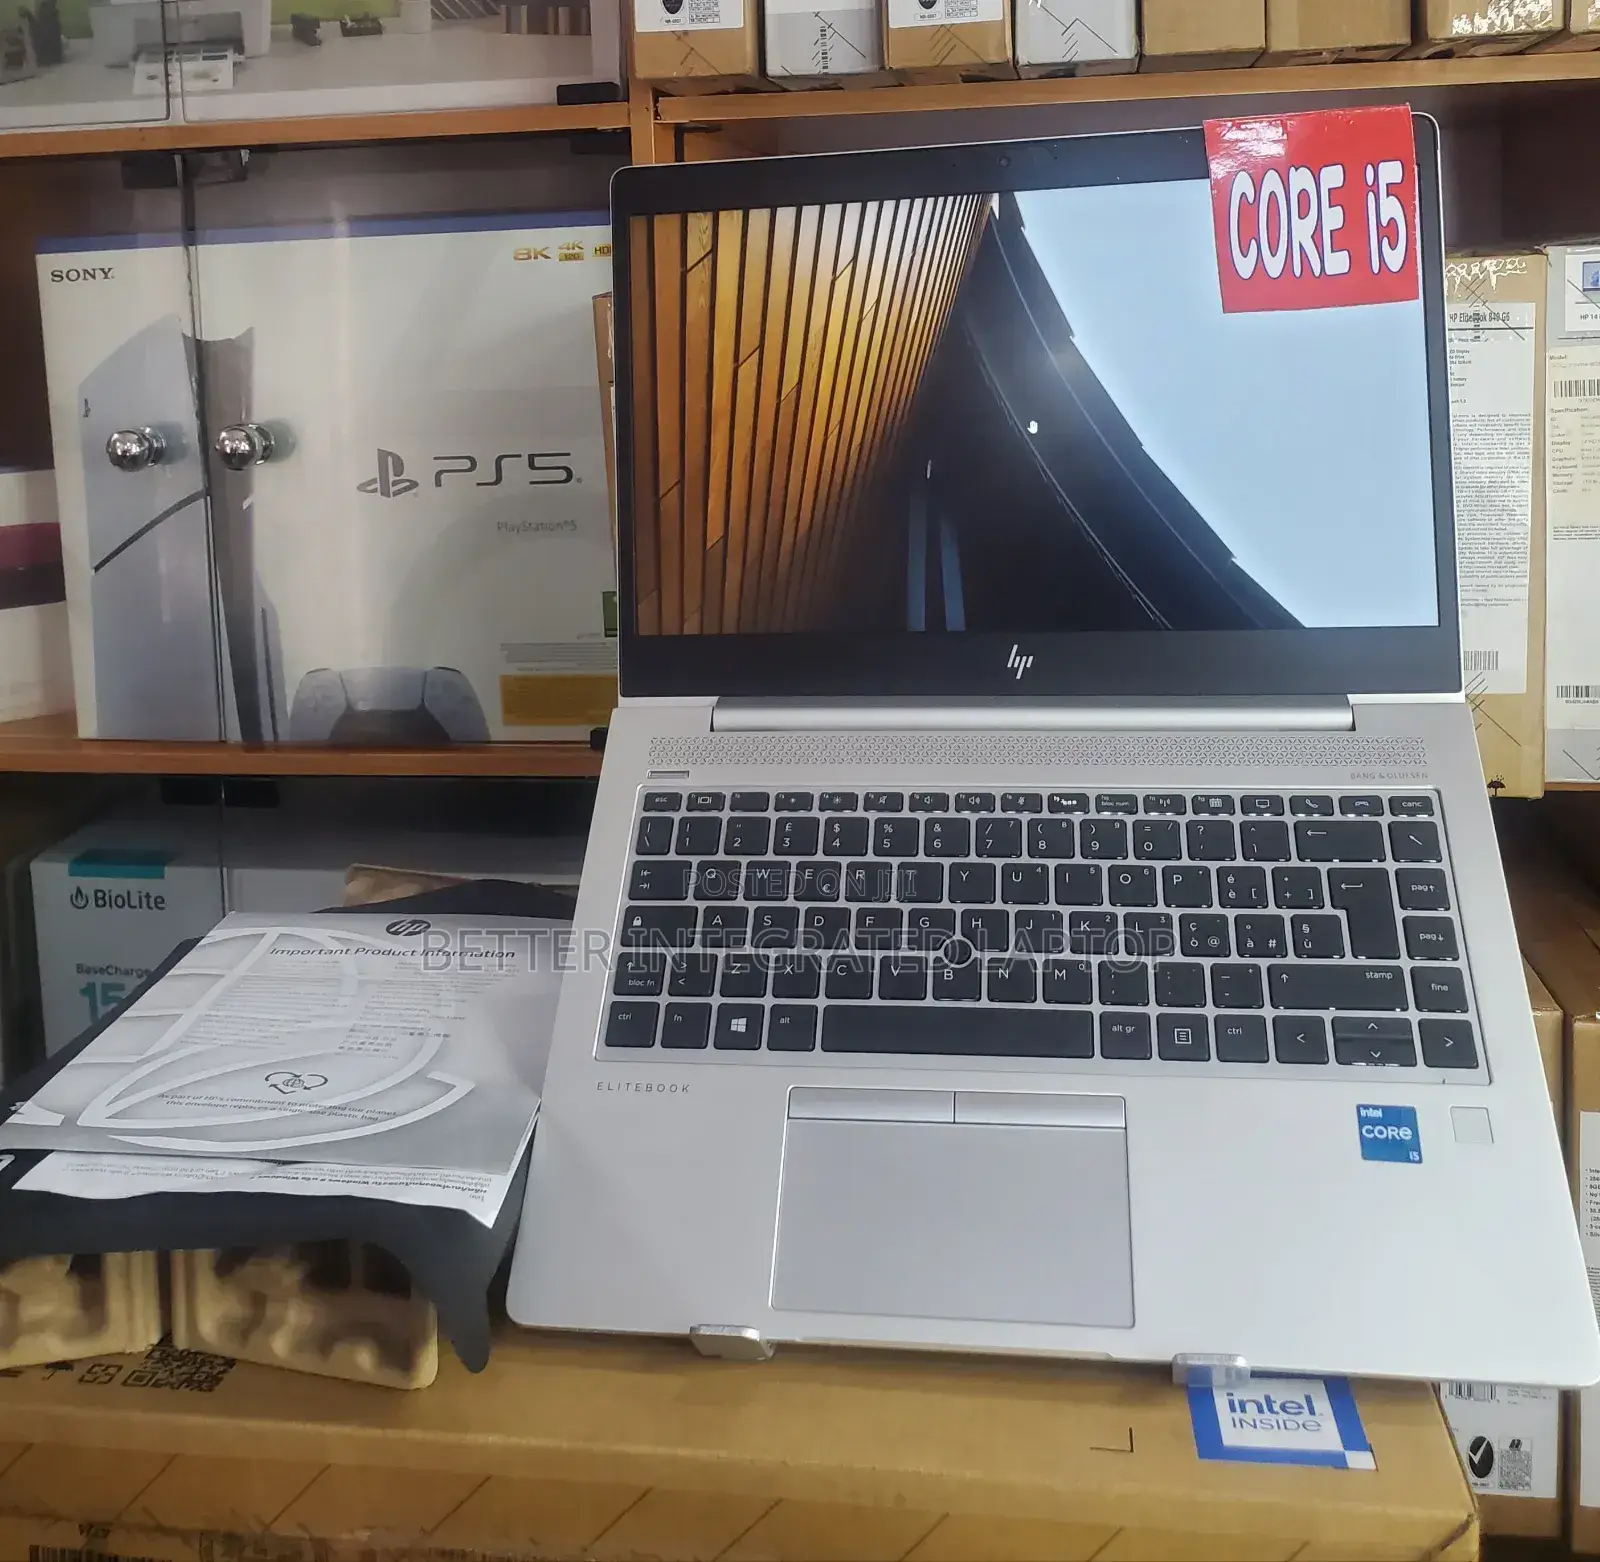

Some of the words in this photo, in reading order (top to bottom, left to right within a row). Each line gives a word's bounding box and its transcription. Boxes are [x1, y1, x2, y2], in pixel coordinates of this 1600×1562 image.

[1228, 163, 1351, 281] CORE
[1364, 160, 1408, 276] i5
[558, 240, 584, 250] 4K
[594, 246, 612, 255] HD
[514, 246, 552, 260] 8K
[50, 268, 113, 283] SONY
[433, 452, 574, 488] PS5
[1007, 644, 1034, 680] hp
[833, 822, 840, 833] $
[884, 824, 893, 833] %
[933, 823, 942, 832] &
[733, 837, 742, 848] 2
[782, 837, 790, 848] 3
[832, 837, 841, 848] 4
[882, 838, 890, 848] 5
[933, 838, 942, 848] 6
[985, 839, 994, 850] 7
[1038, 840, 1046, 850] 8
[1091, 841, 1100, 851] 9
[756, 868, 770, 878] W
[805, 869, 814, 879] E
[856, 870, 865, 880] R
[960, 871, 970, 881] Y
[1012, 871, 1022, 882] U
[1173, 874, 1182, 885] P
[94, 888, 166, 910] BioLite
[712, 915, 723, 926] A
[763, 915, 772, 926] S
[814, 916, 824, 926] D
[866, 917, 874, 927] F
[919, 917, 930, 928] G
[972, 918, 982, 928] H
[1025, 919, 1033, 930] J
[1080, 920, 1091, 931] K
[1135, 922, 1144, 933] L
[1208, 936, 1220, 947] @
[1268, 939, 1277, 948] #
[270, 947, 350, 957] Important
[355, 947, 416, 957] Product
[420, 949, 515, 958] Information
[76, 963, 151, 979] BaseCharge
[732, 964, 741, 974] Z
[784, 964, 794, 975] X
[837, 964, 847, 975] C
[891, 965, 900, 976] V
[999, 968, 1008, 978] N
[1054, 969, 1066, 980] M
[944, 970, 954, 980] B
[1365, 971, 1393, 980] stamp
[1431, 983, 1448, 992] fine
[674, 1014, 682, 1022] fn
[1112, 1024, 1122, 1032] alt
[1125, 1026, 1136, 1035] gr
[1227, 1027, 1242, 1036] ctrl
[597, 1081, 690, 1093] ELITEBOOK
[1360, 1107, 1383, 1118] intel
[1226, 1392, 1318, 1417] intel
